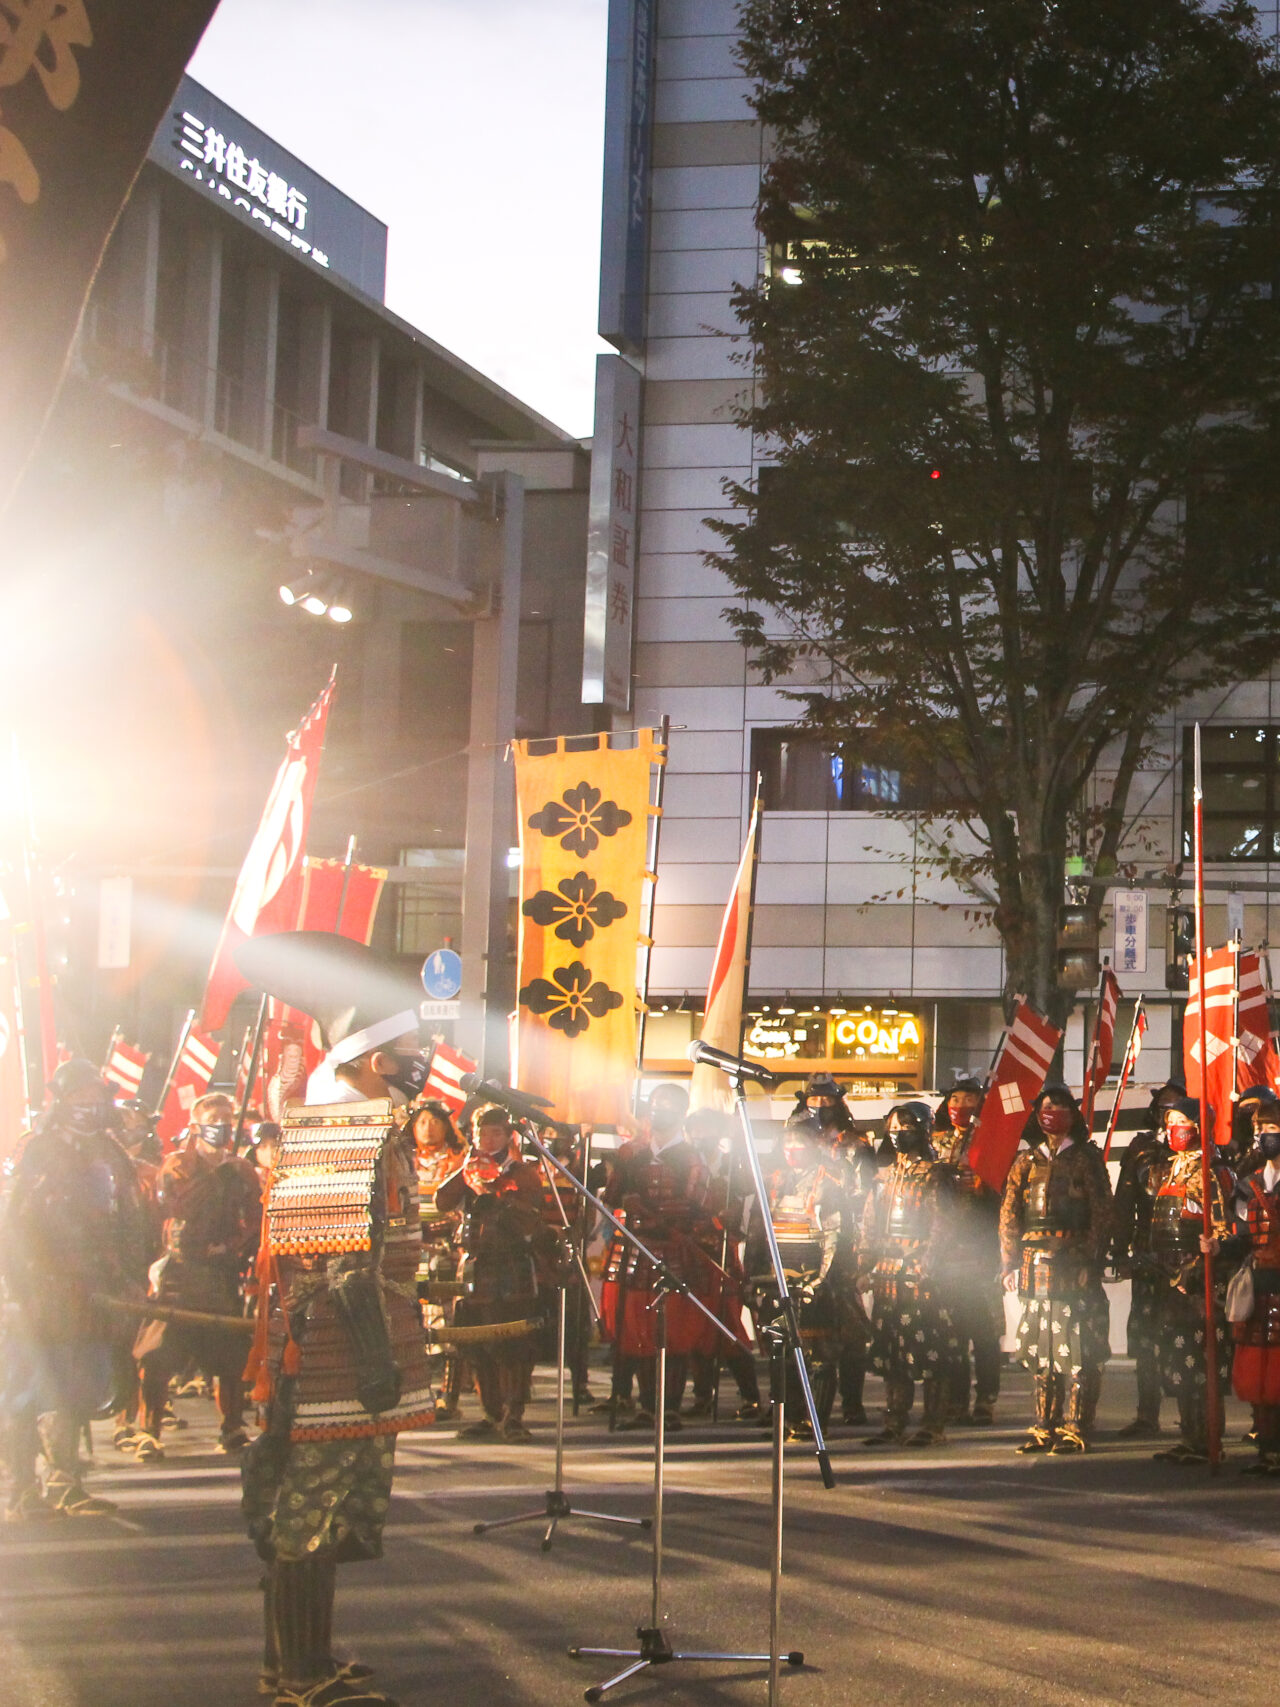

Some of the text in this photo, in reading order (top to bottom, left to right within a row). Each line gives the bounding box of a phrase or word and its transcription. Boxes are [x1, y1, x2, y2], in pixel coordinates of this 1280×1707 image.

[180, 111, 308, 231] 三井住友銀行
[612, 411, 634, 626] 大和証券
[1125, 913, 1137, 970] 歩車分離式
[836, 1019, 919, 1054] CONA
